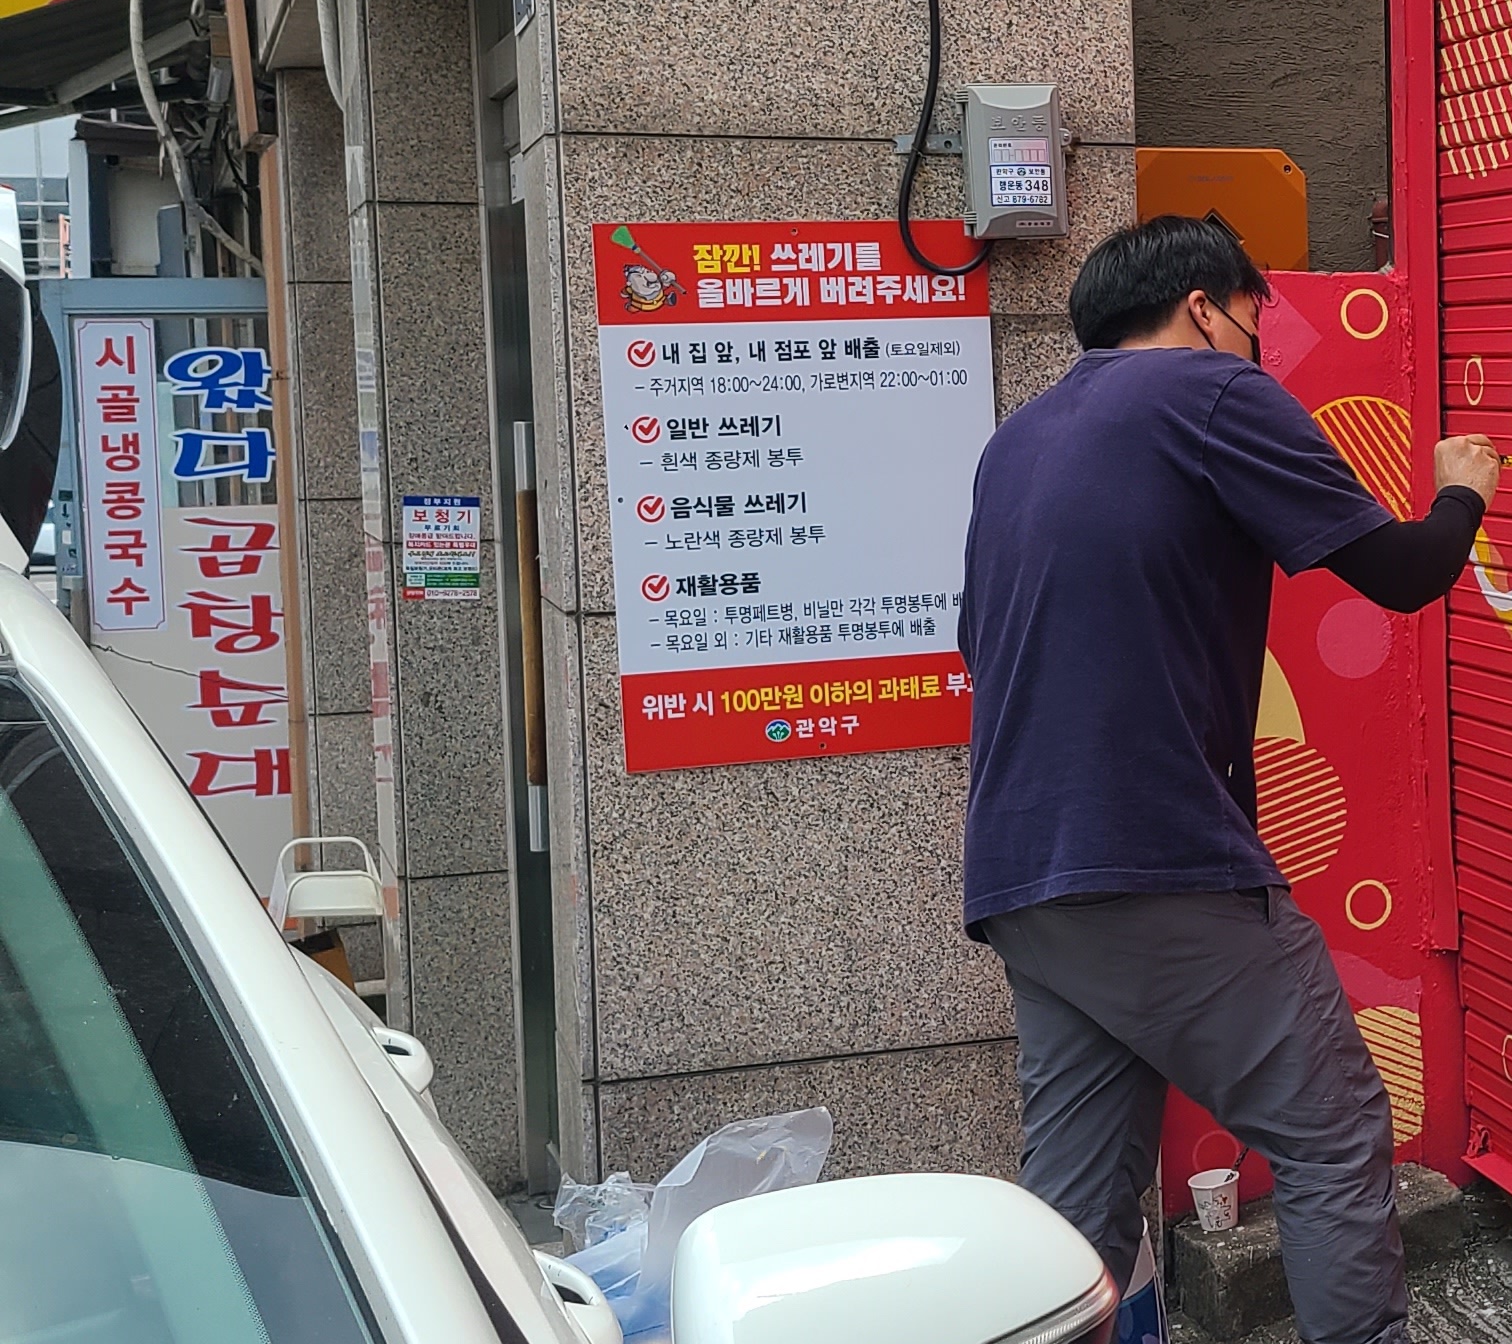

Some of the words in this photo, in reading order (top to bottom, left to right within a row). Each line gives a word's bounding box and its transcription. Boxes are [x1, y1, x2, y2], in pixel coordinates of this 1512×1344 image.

[990, 115, 1047, 131] 보안등
[996, 195, 1010, 204] 신고
[1025, 179, 1049, 192] 348
[692, 243, 760, 274] 잠깐!
[770, 242, 882, 272] 쓰레기를
[697, 275, 811, 308] 올바르게
[819, 274, 967, 306] 버려주세요!
[661, 341, 681, 365] 내
[688, 341, 707, 364] 집
[714, 340, 741, 364] 앞,
[748, 339, 767, 362] 내
[774, 339, 813, 362] 점포
[818, 338, 837, 361] 앞
[844, 336, 881, 360] 배출
[885, 339, 961, 358] (토요일제외)
[649, 375, 704, 397] 주거지역
[810, 369, 876, 392] 가로변지역
[880, 368, 968, 389] 22:00~01:00
[666, 416, 709, 440] 일반
[717, 414, 782, 437] 쓰레기
[660, 451, 698, 472] 흰색
[704, 449, 760, 470] 종량제
[767, 447, 804, 468] 봉투
[95, 334, 152, 617] 시골냉콩국수
[412, 509, 472, 524] 보청기
[670, 494, 736, 519] 음식물
[743, 491, 807, 515] 쓰레기
[665, 529, 721, 551] 노란색
[727, 526, 783, 549] 종량제
[789, 524, 826, 545] 봉투
[675, 572, 762, 598] 재활용품
[664, 608, 707, 628] 목요일
[803, 599, 844, 620] 비닐만
[848, 597, 876, 617] 각각
[880, 593, 948, 615] 투명봉투에
[666, 632, 709, 652] 목요일
[714, 631, 728, 650] 외
[745, 628, 773, 648] 기타
[778, 624, 833, 645] 재활용품
[838, 619, 905, 642] 투명봉투에
[910, 616, 937, 637] 배출
[177, 517, 293, 797] 곱창순대
[641, 693, 686, 720] 위반
[692, 690, 715, 716] 시
[720, 683, 803, 714] 100만원
[809, 678, 874, 707] 이하의
[878, 674, 941, 702] 과태료
[795, 715, 860, 739] 관악구
